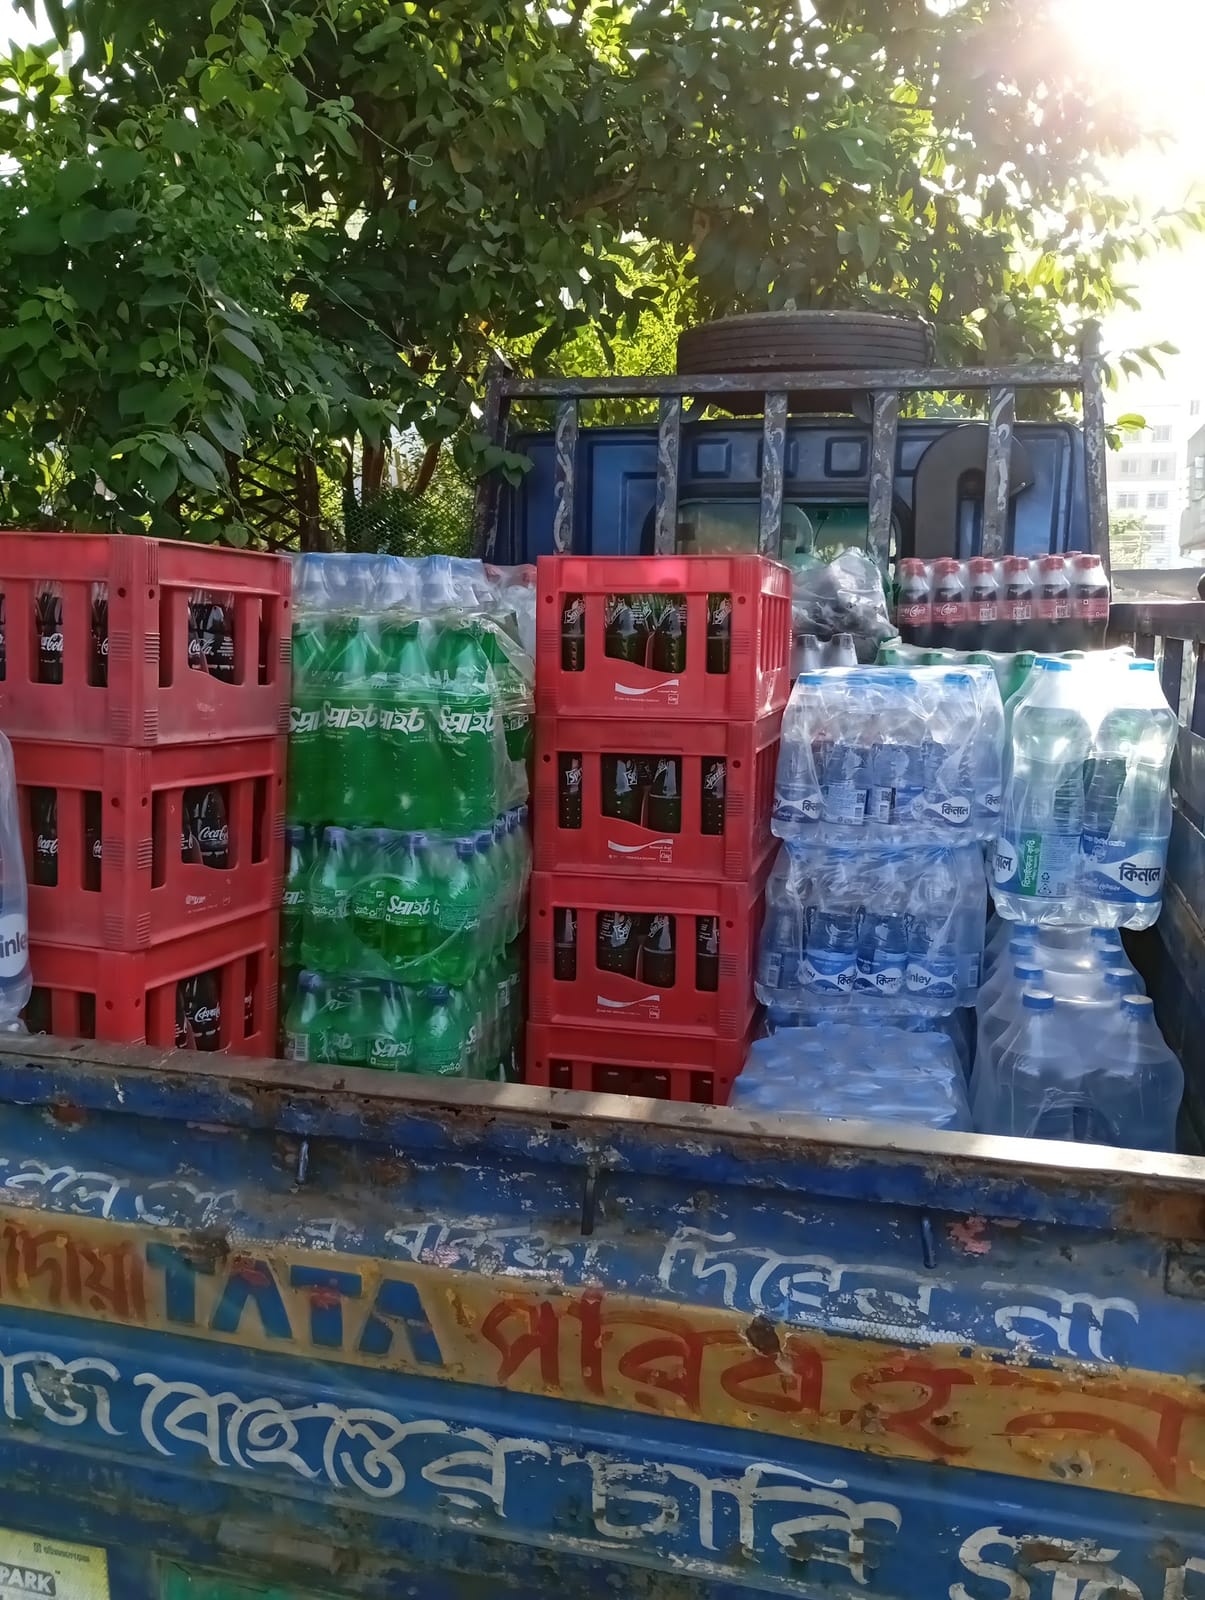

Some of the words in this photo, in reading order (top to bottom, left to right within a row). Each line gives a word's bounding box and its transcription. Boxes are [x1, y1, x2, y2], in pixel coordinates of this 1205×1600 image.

[0, 931, 27, 959] inle
[909, 972, 932, 986] nley
[145, 1242, 443, 1366] TATA
